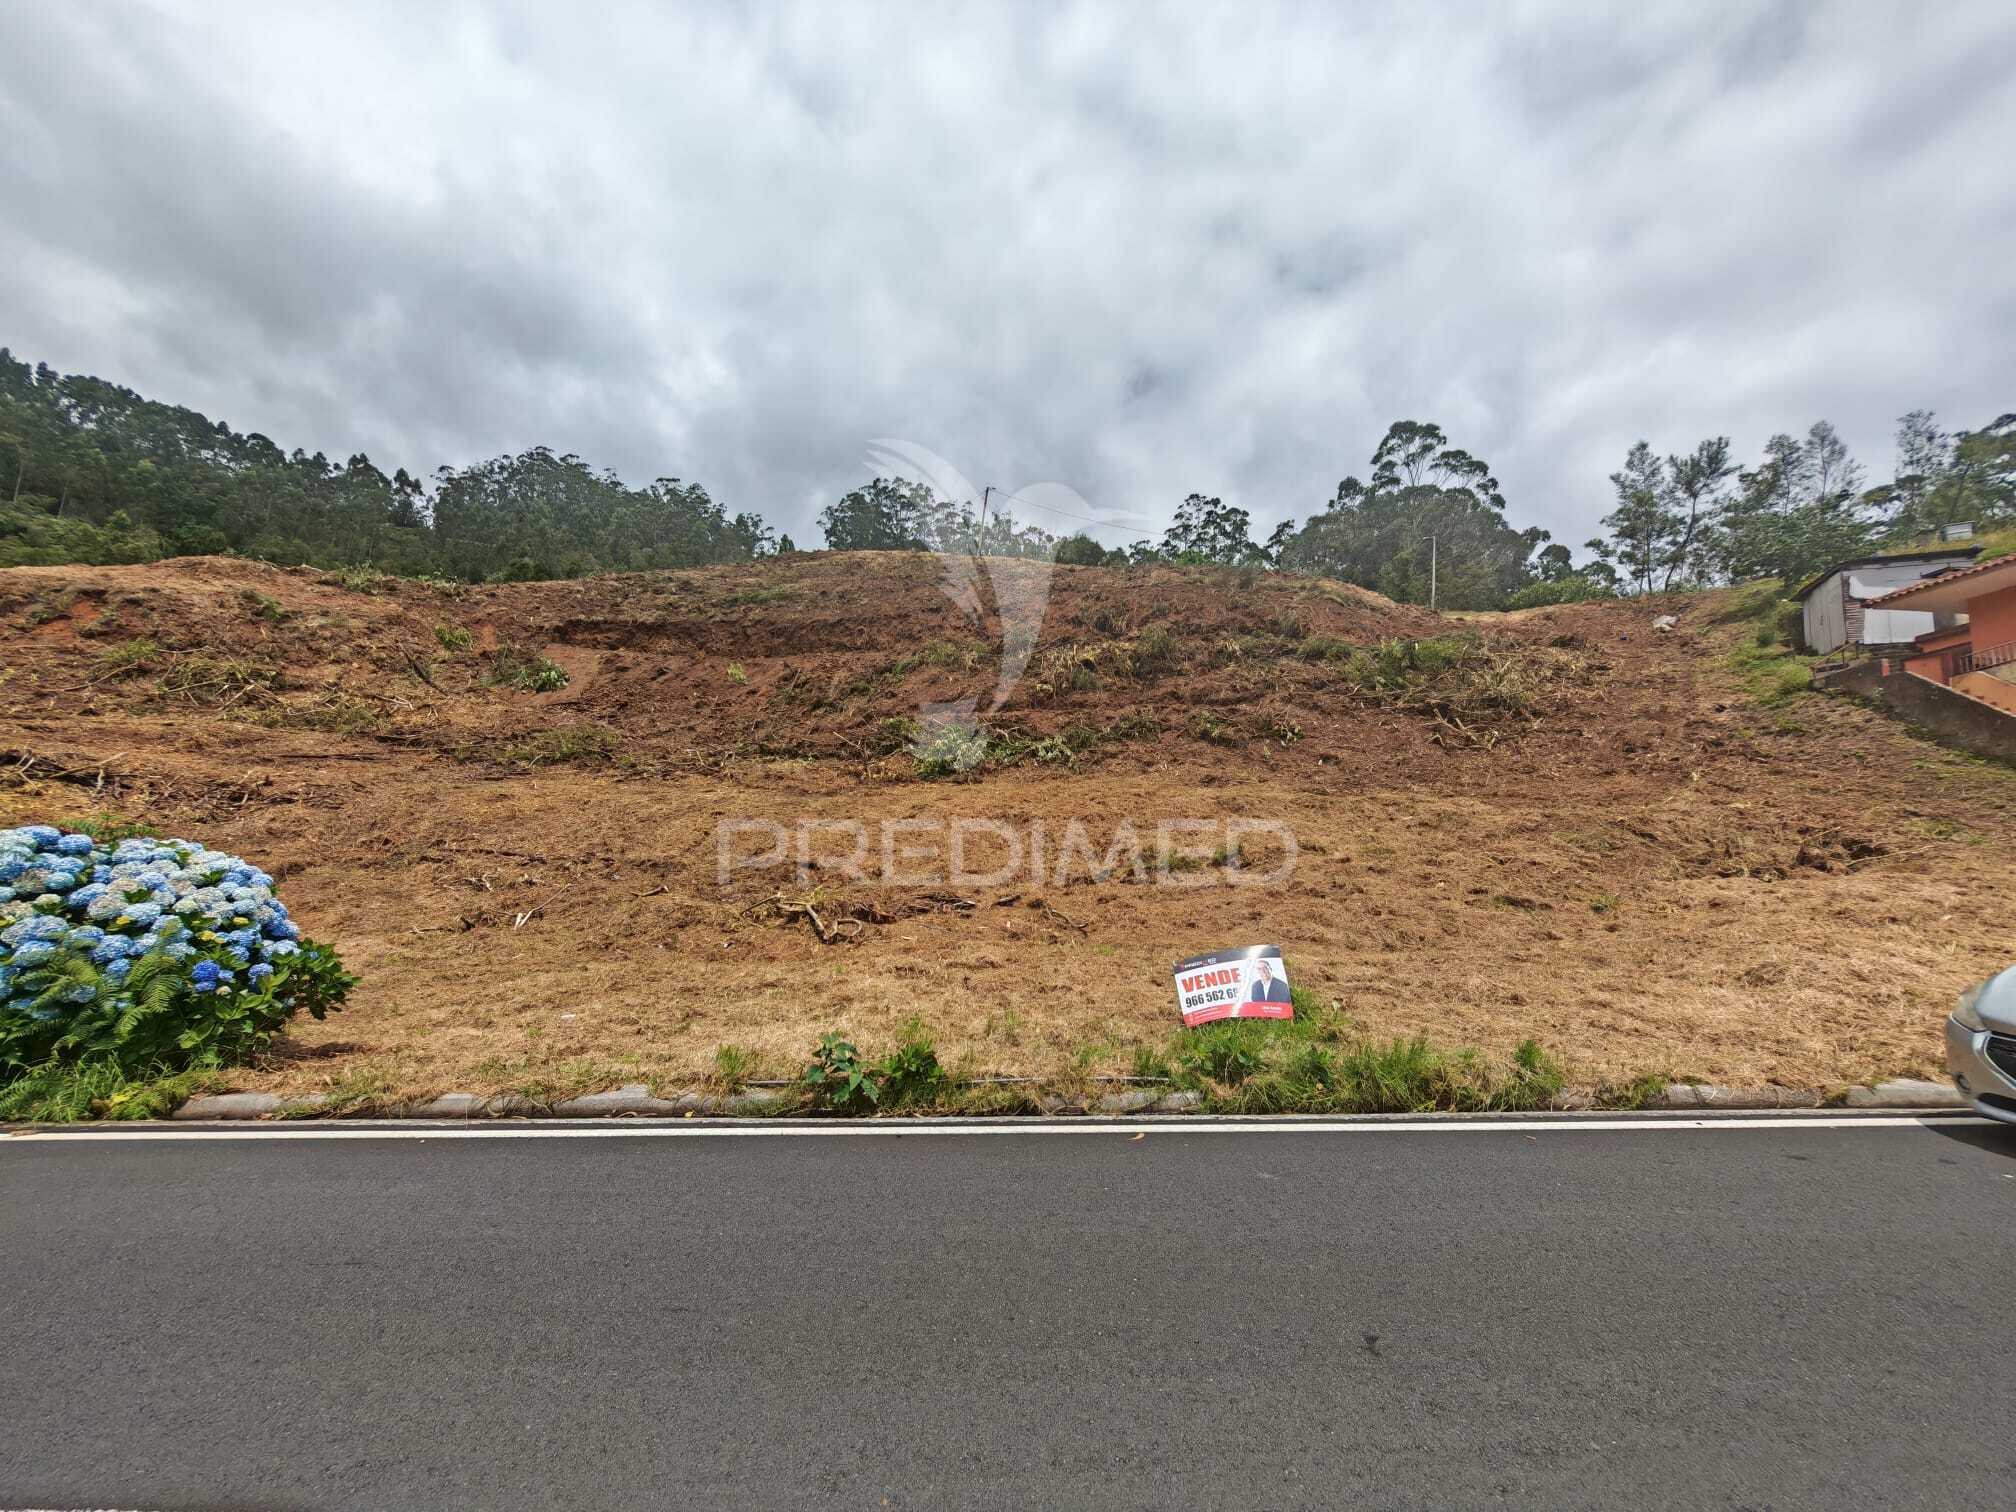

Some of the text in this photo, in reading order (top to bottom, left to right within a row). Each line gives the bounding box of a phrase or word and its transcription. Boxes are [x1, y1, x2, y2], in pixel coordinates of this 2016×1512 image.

[1181, 967, 1241, 993] VENDE
[1185, 994, 1205, 1008] 966
[1206, 988, 1225, 1003] 562
